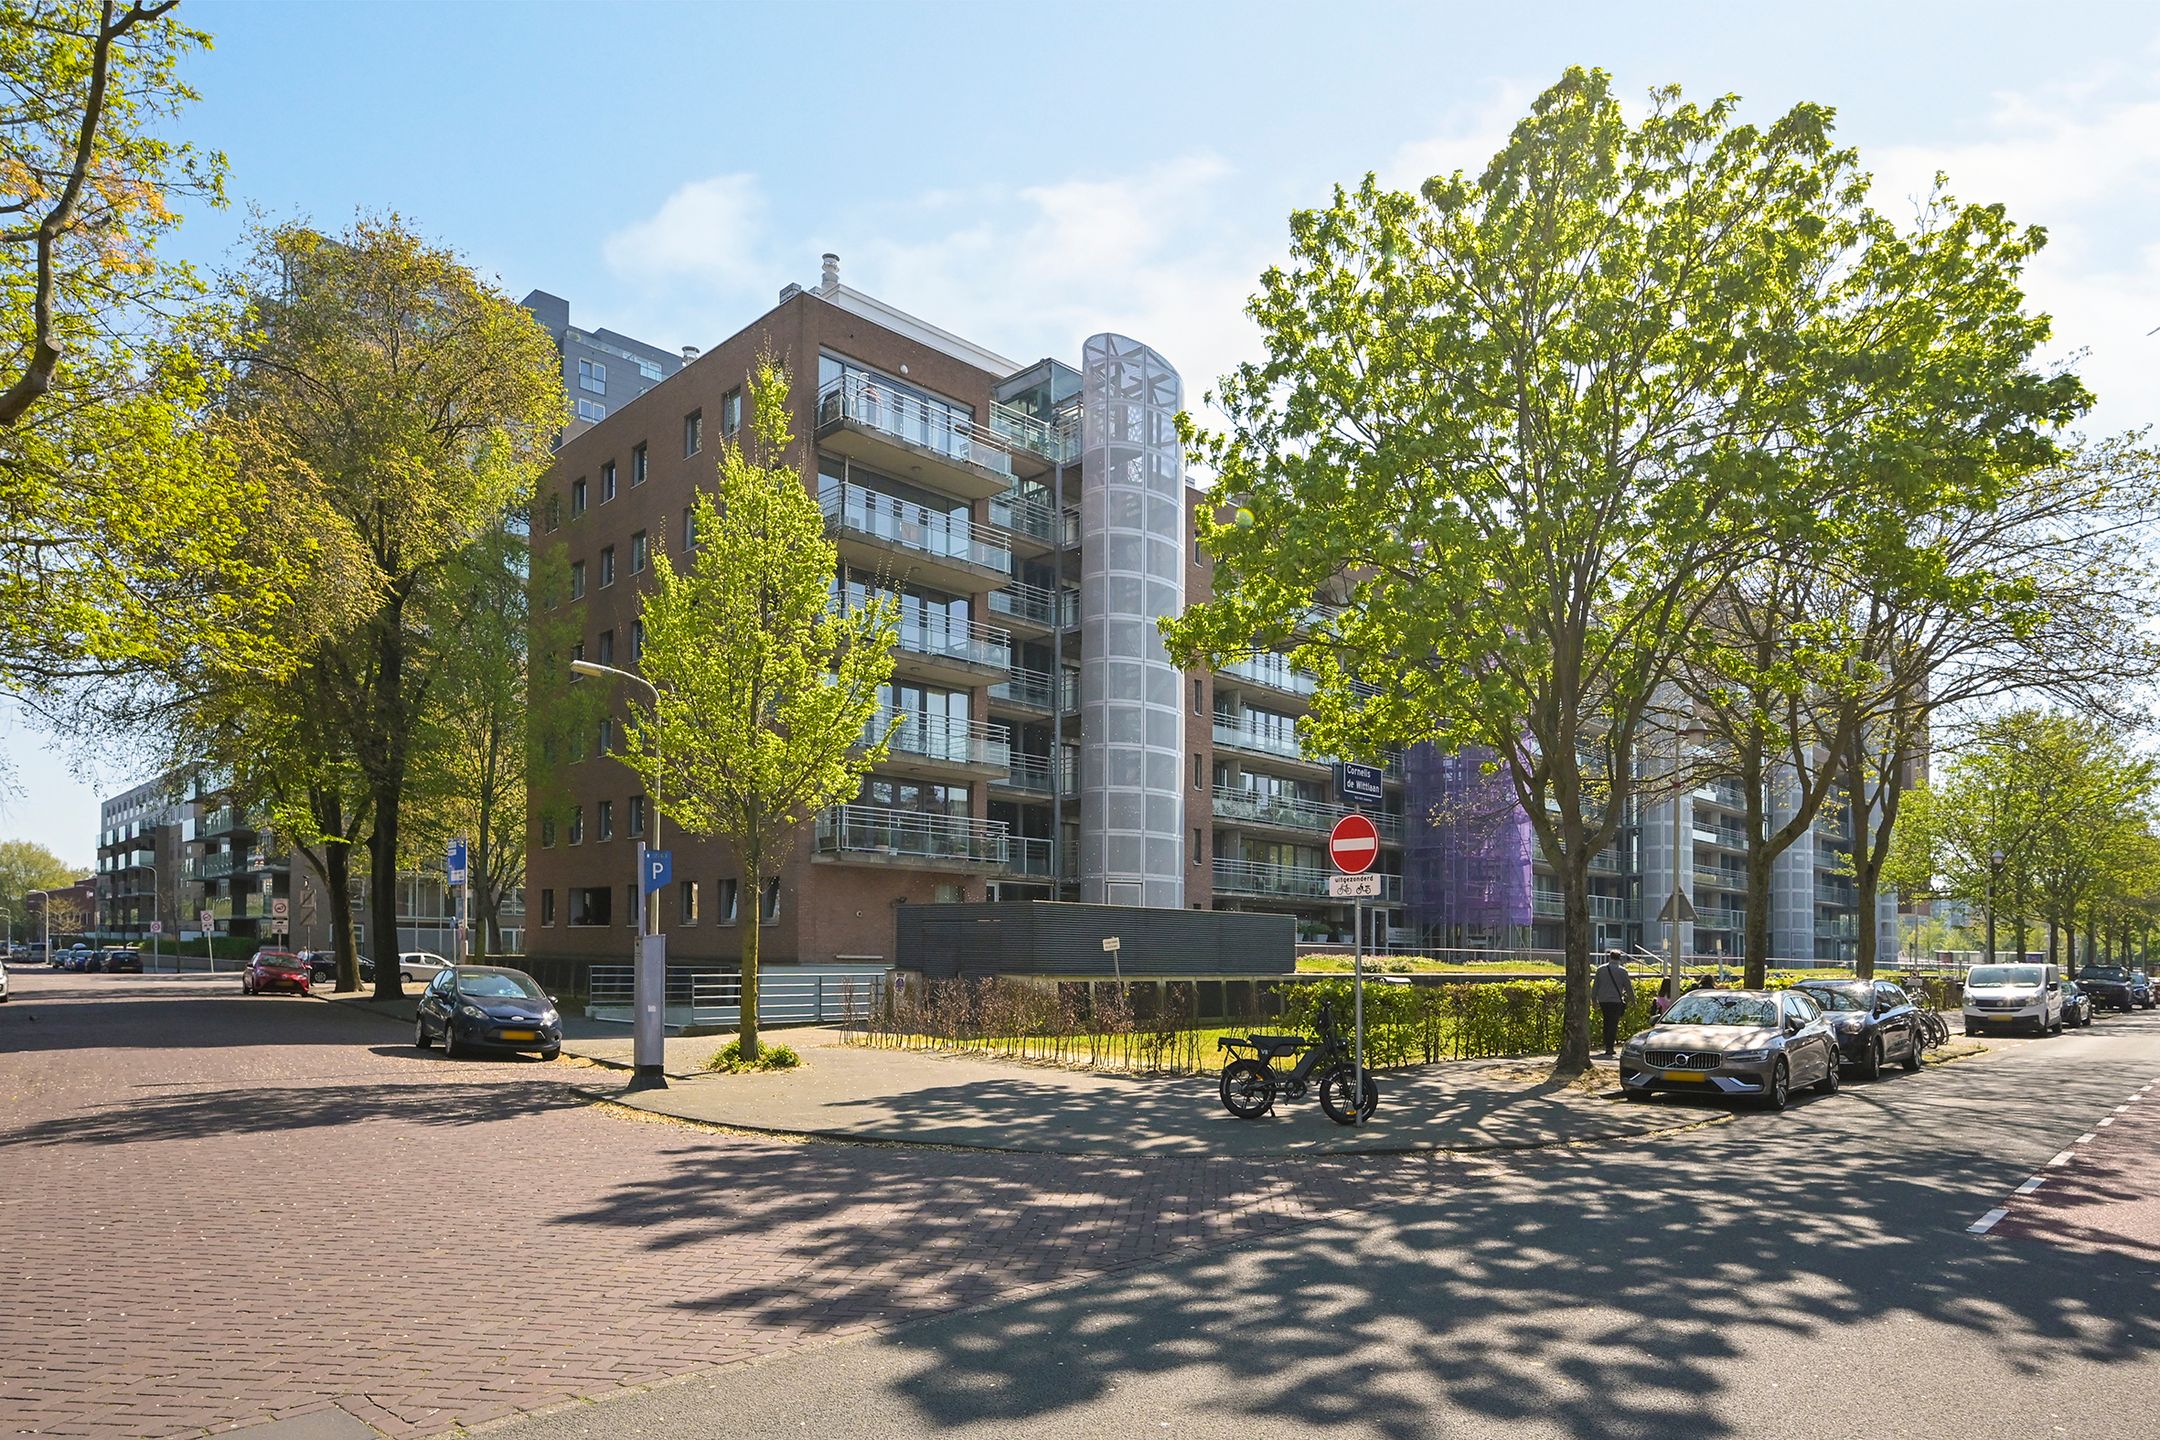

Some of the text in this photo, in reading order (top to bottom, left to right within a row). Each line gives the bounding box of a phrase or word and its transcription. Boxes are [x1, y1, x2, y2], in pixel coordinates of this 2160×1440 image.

[1347, 765, 1371, 778] Cornelis
[1347, 779, 1379, 793] de Wittlaan
[652, 862, 664, 880] P
[1335, 875, 1373, 883] uitgezonderd
